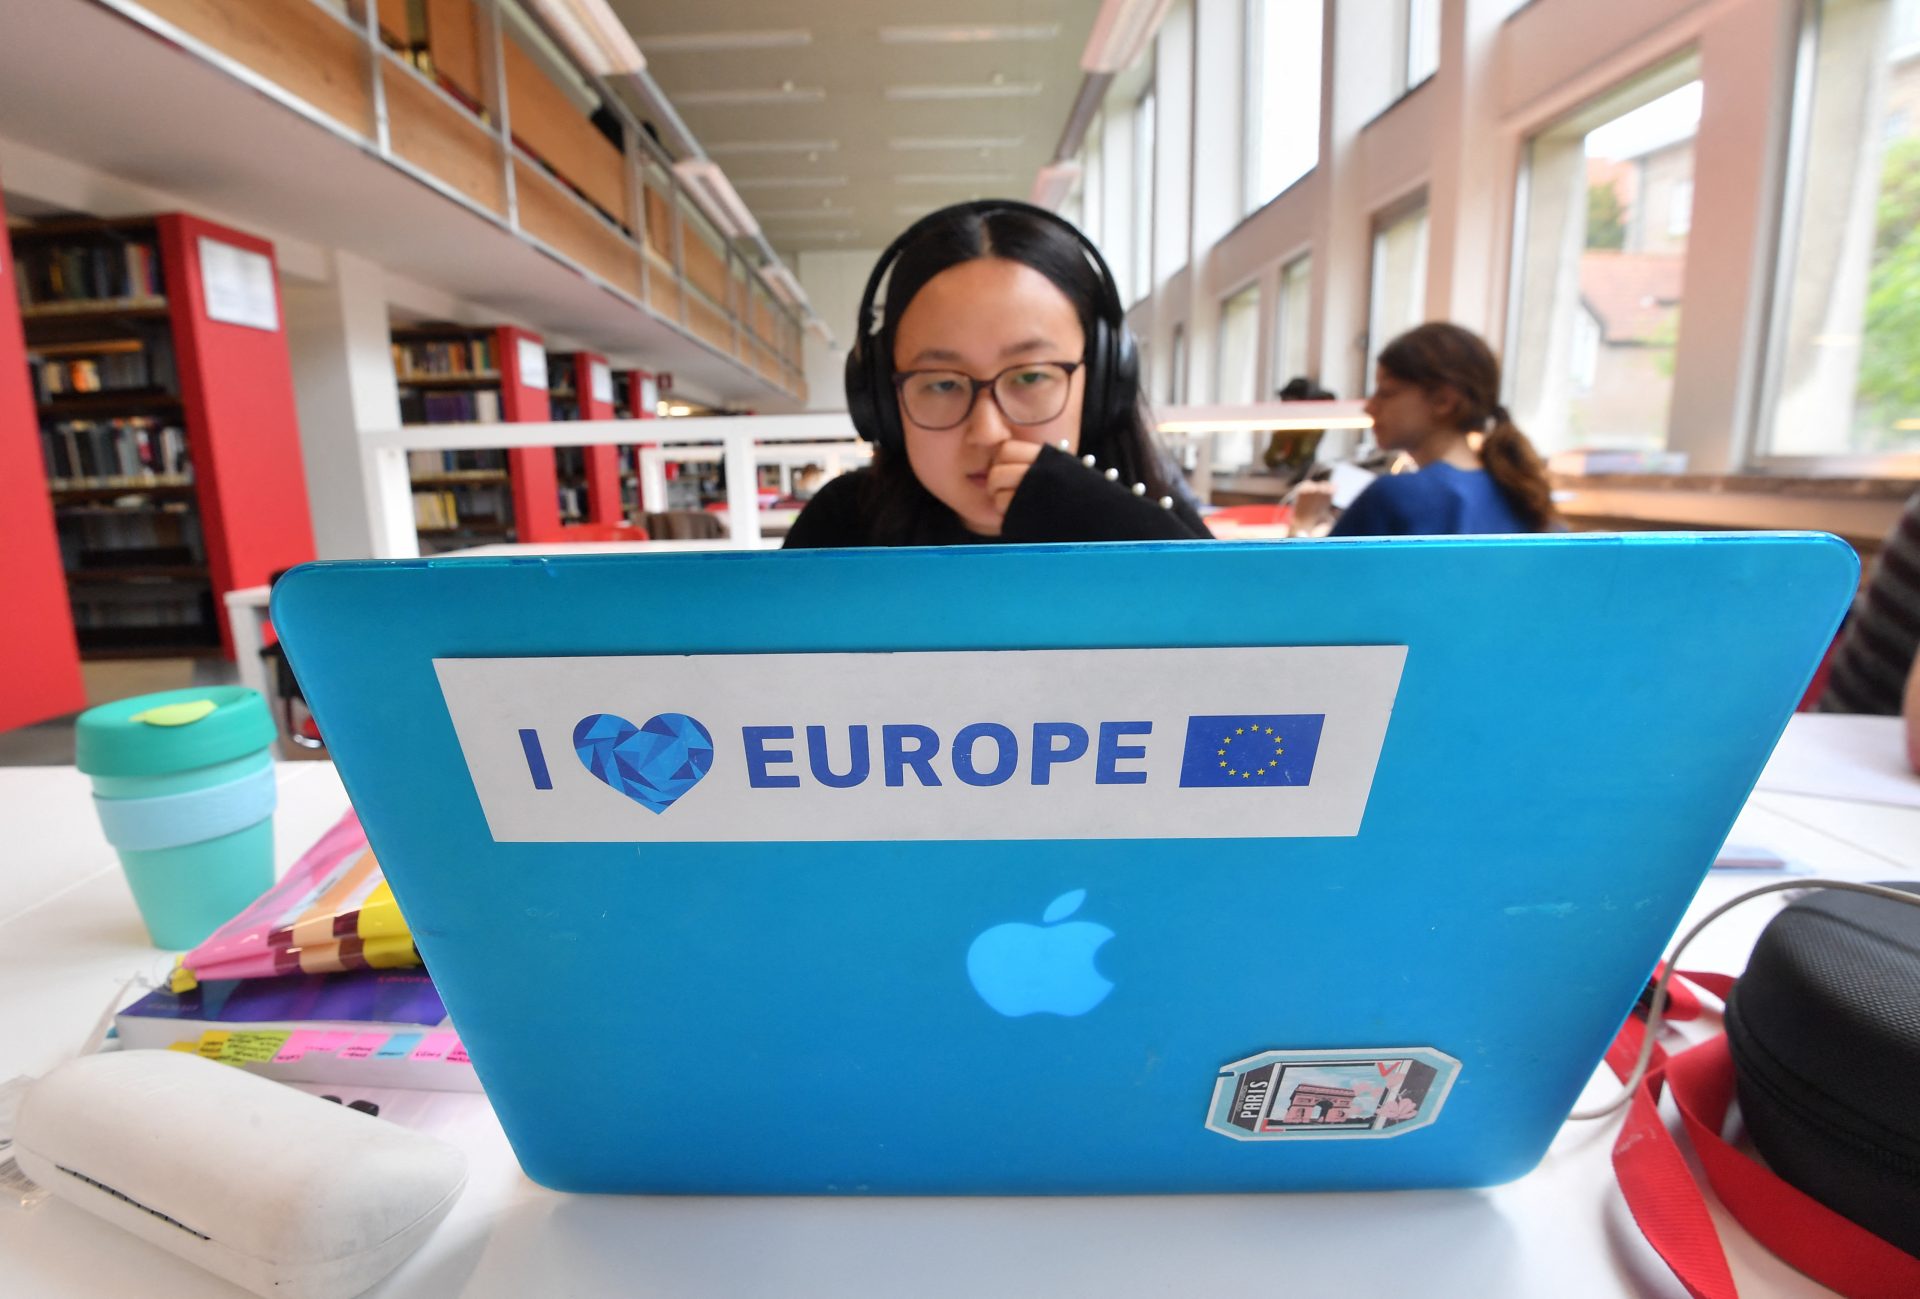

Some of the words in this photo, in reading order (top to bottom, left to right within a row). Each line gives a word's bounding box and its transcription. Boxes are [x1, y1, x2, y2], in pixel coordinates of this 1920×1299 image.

[518, 729, 553, 790] I
[742, 721, 1153, 788] EUROPE
[1240, 1081, 1268, 1118] PARIS
